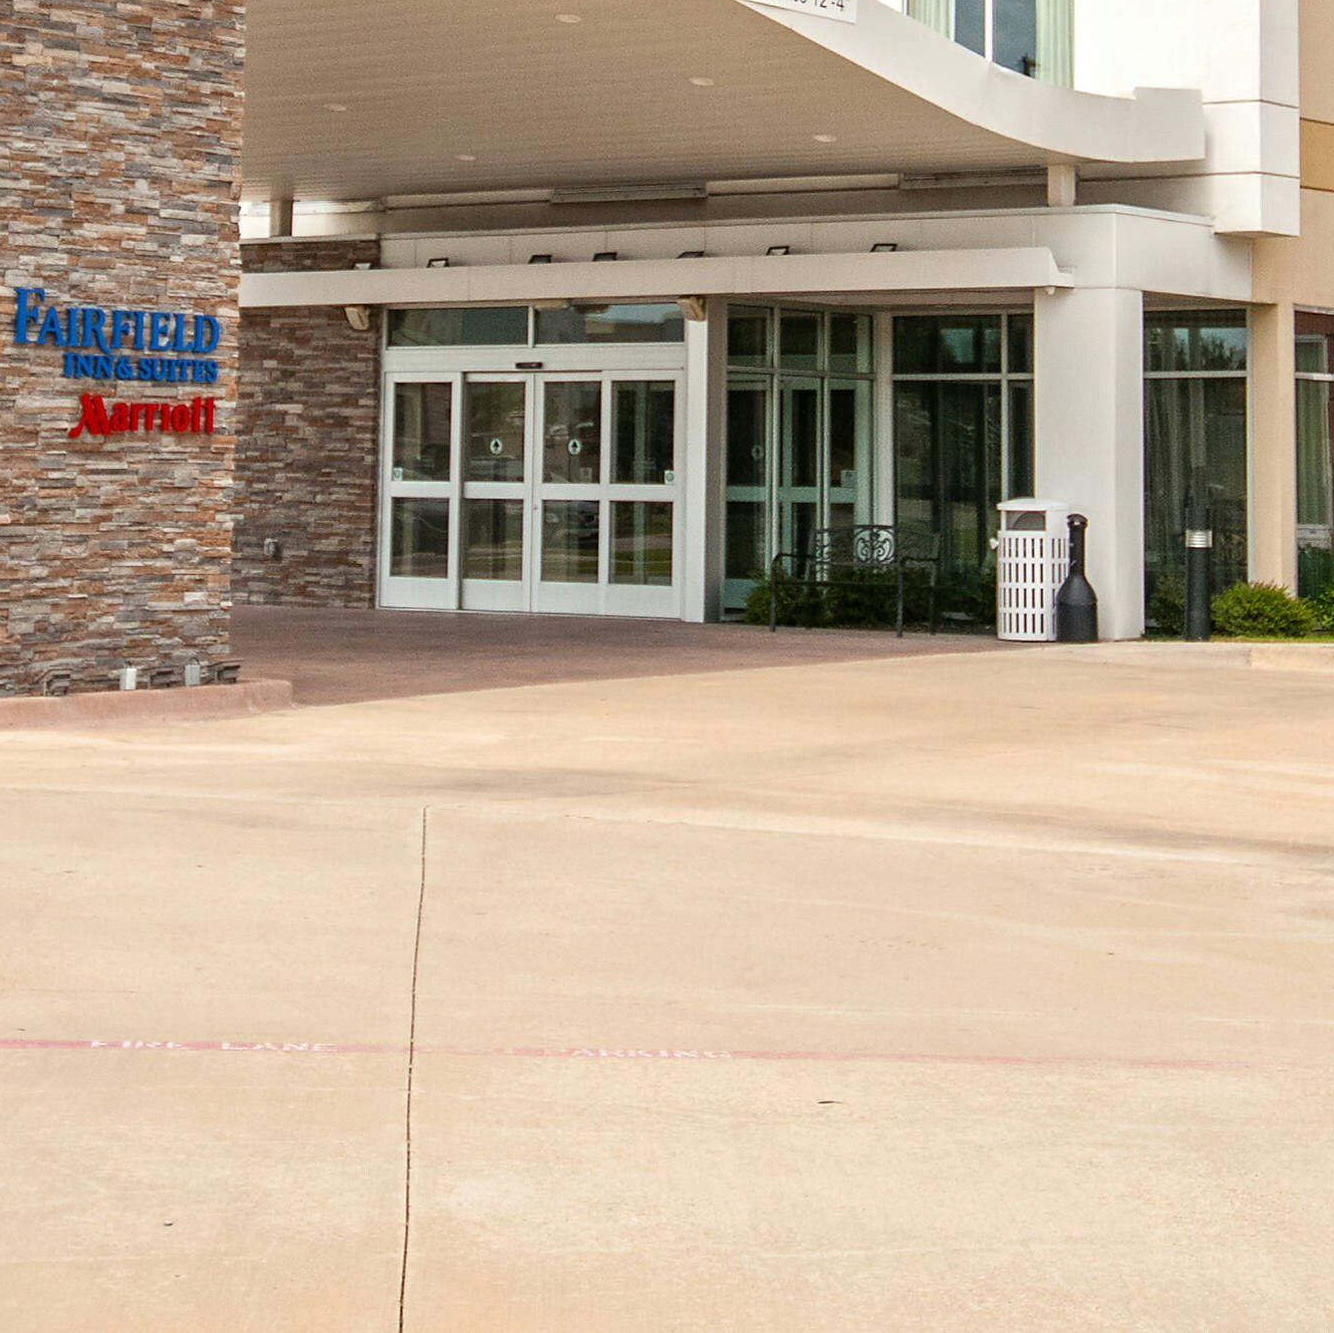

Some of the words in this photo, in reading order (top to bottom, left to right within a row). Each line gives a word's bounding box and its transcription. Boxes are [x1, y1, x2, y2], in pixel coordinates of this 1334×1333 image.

[14, 286, 221, 354] FAIRFIELD
[68, 392, 216, 439] Marriott
[220, 1040, 340, 1052] LANE
